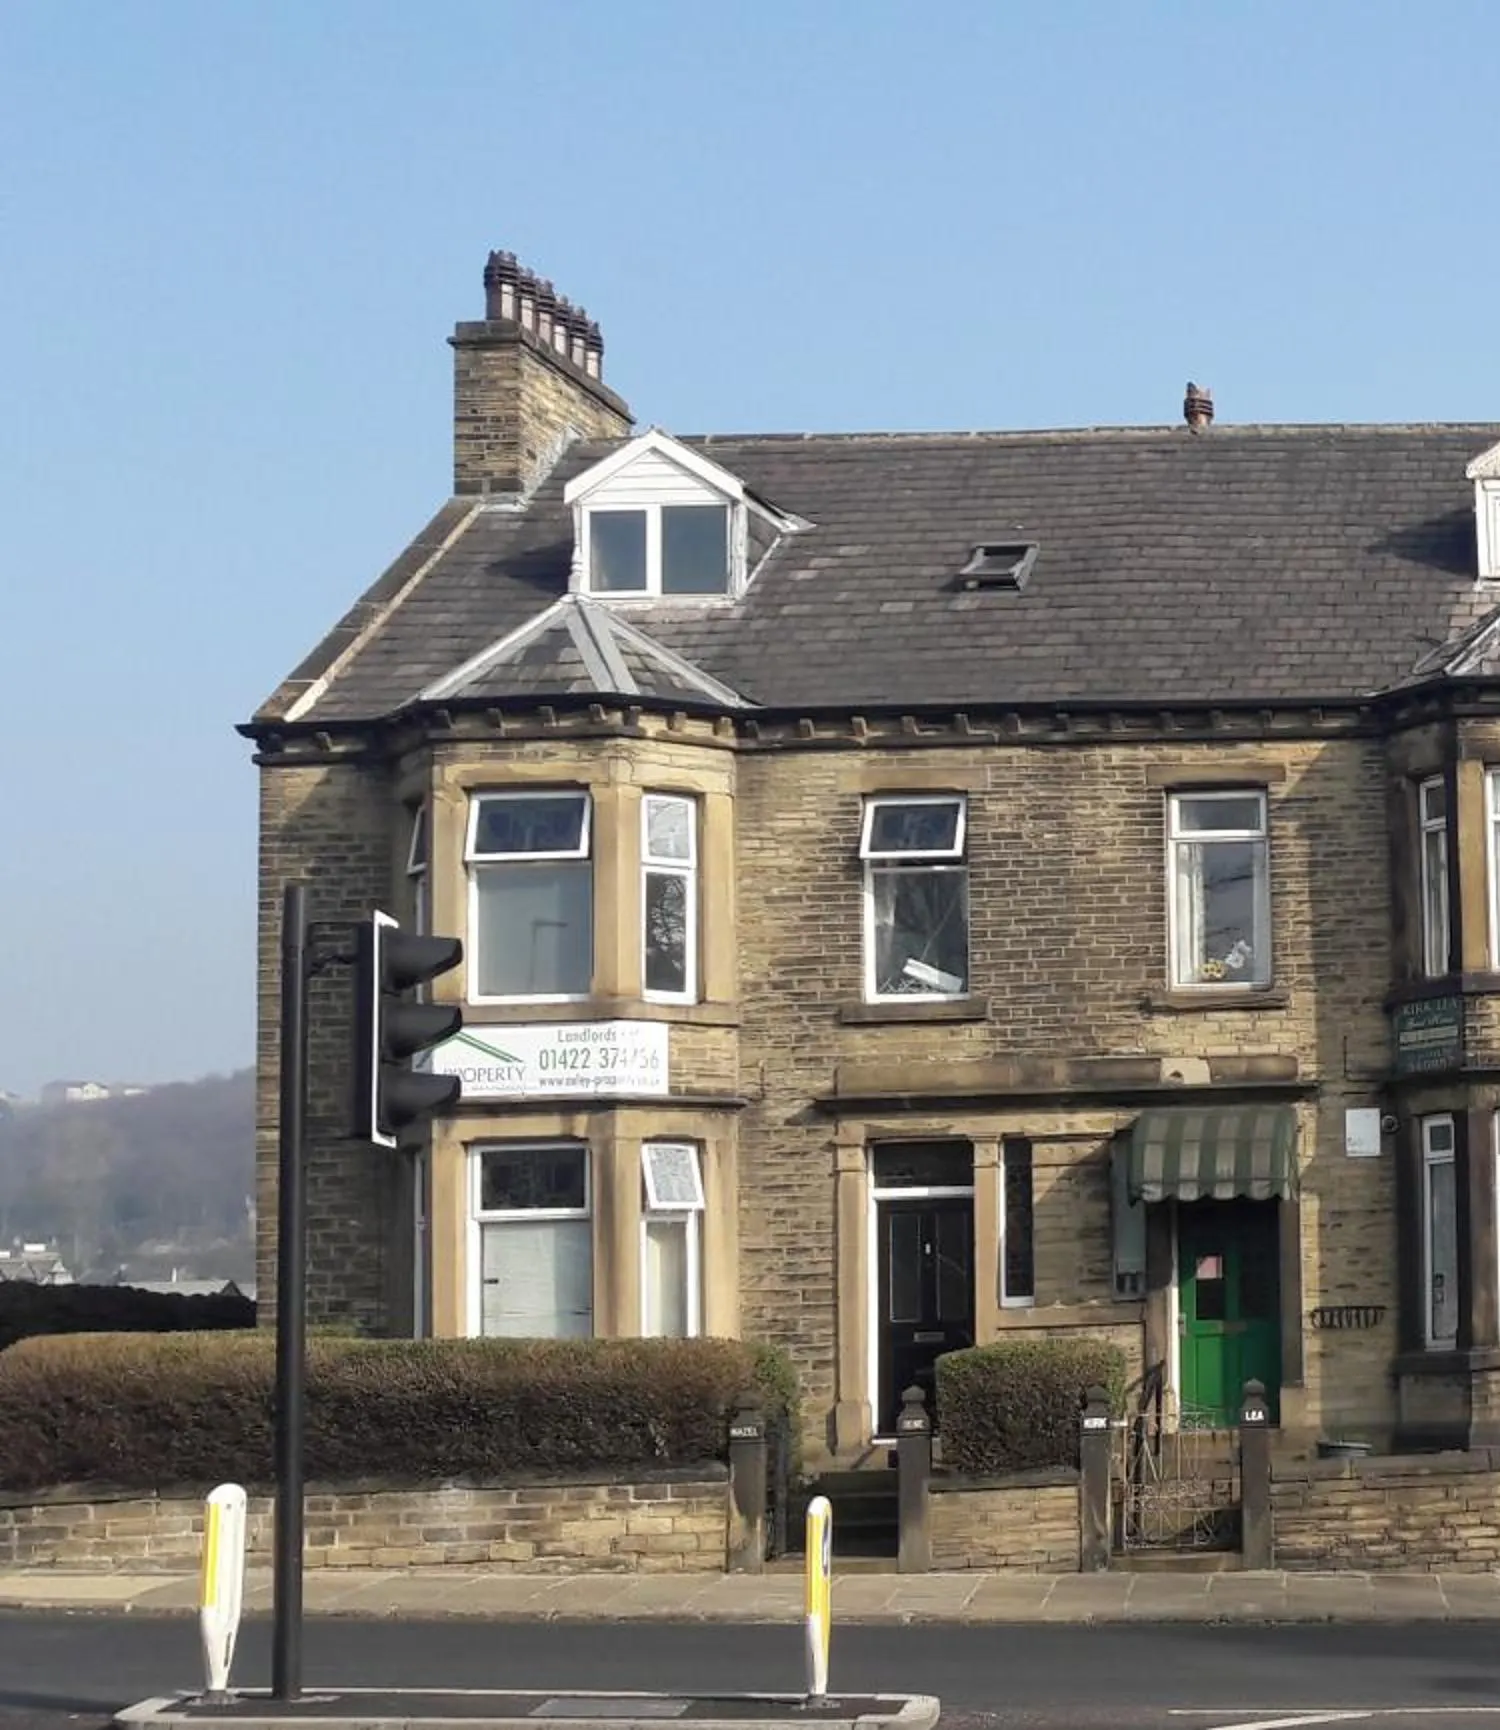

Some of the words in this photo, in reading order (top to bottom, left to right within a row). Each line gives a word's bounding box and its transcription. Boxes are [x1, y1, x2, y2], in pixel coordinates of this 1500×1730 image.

[557, 1028, 617, 1043] Landlords
[539, 1047, 591, 1071] 01422
[1244, 1410, 1265, 1421] LEA
[1083, 1417, 1107, 1429] KIRK
